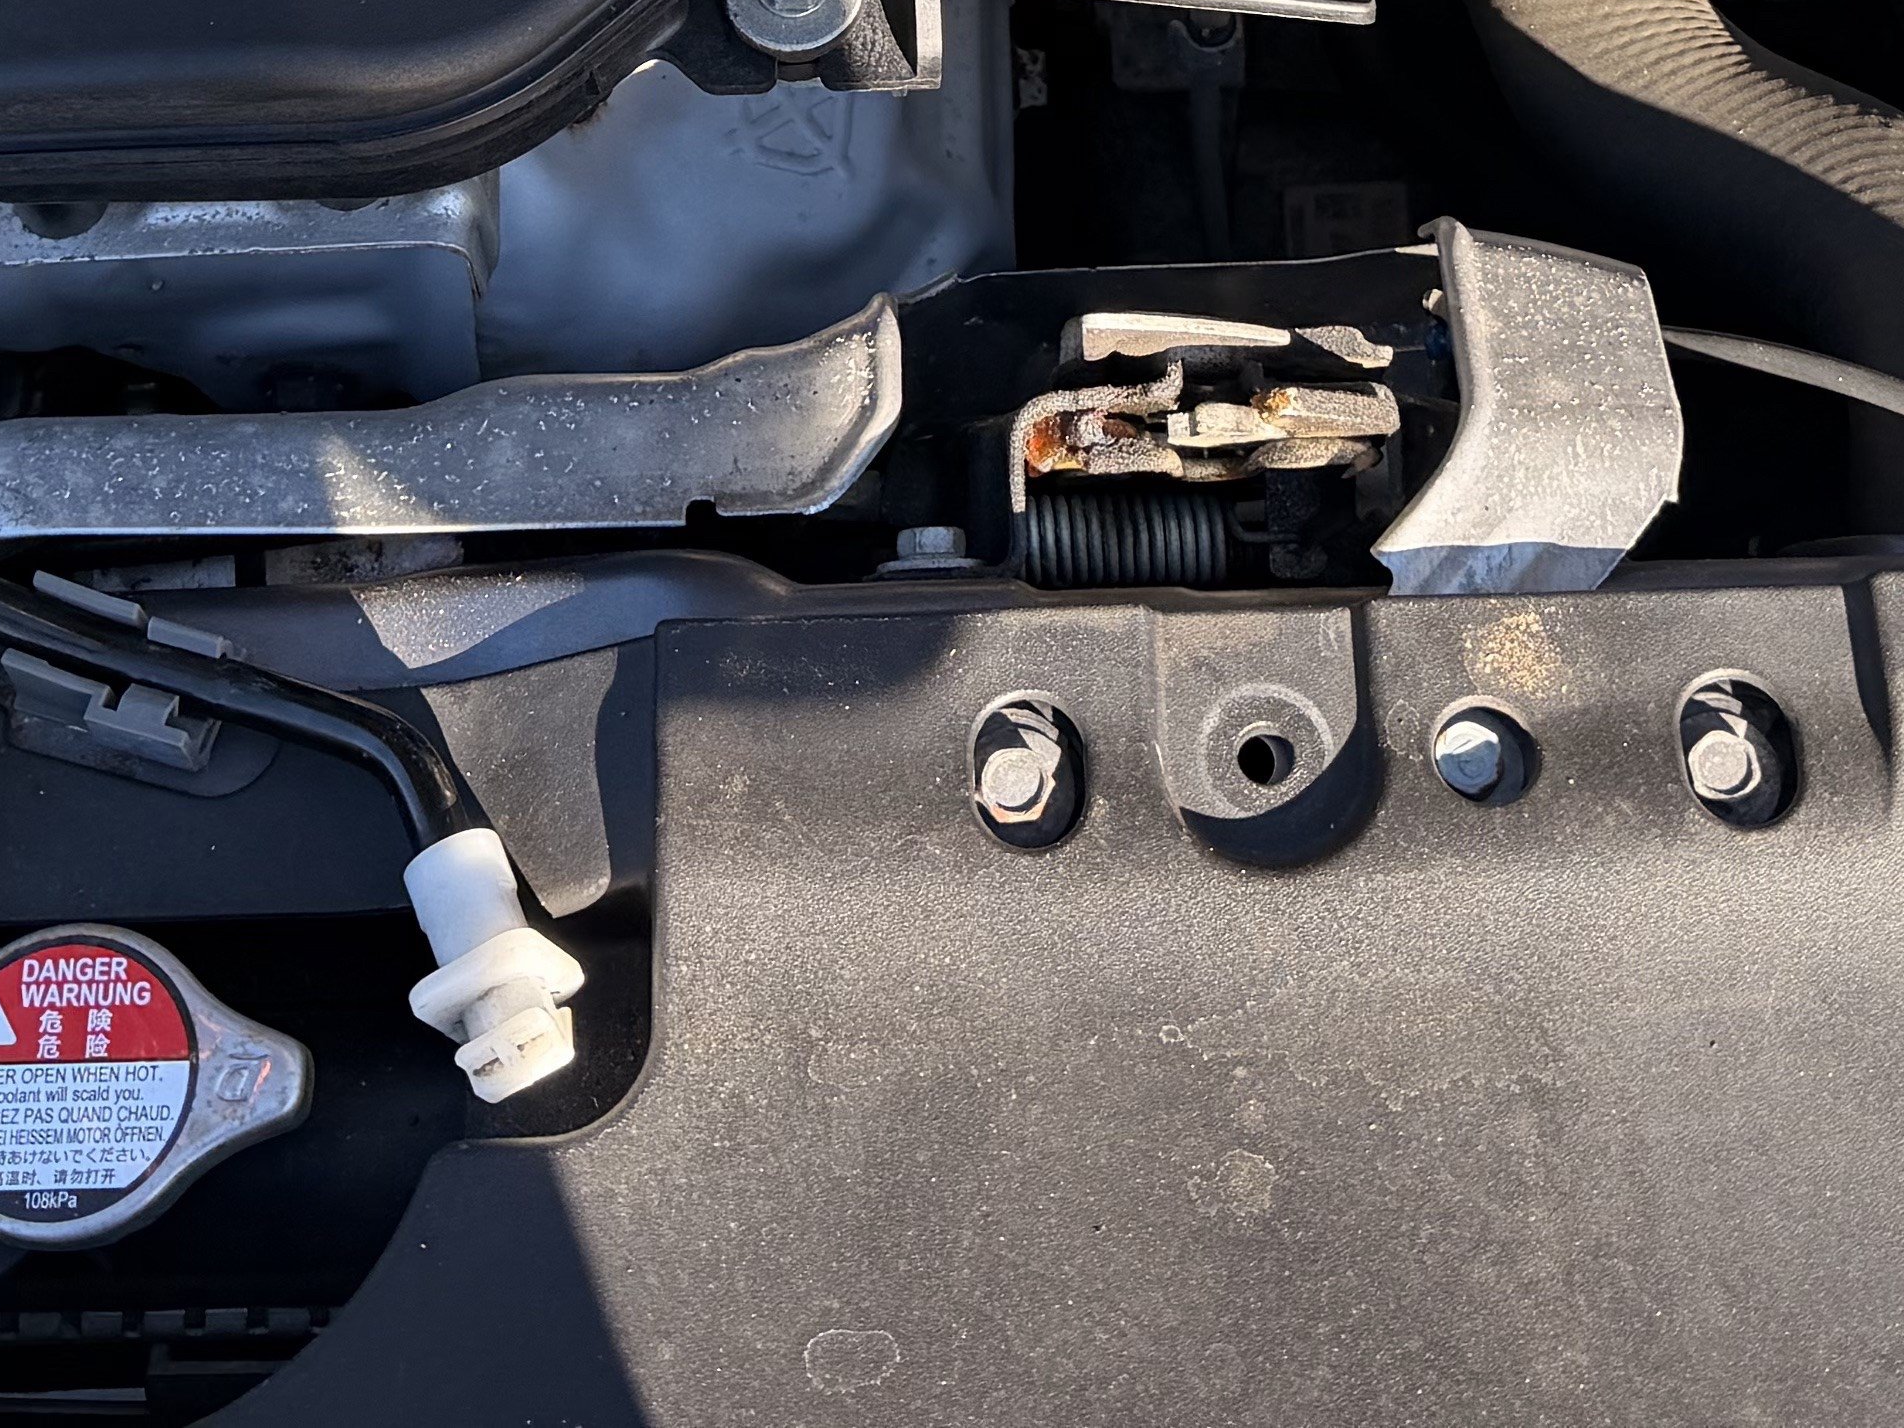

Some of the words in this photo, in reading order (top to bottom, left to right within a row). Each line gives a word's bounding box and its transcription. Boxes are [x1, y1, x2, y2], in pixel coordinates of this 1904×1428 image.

[22, 957, 128, 982] DANGER
[20, 981, 153, 1007] WARNUNG
[21, 1067, 67, 1084] OPEN
[72, 1066, 121, 1084] WHEN
[124, 1065, 164, 1082] HOT.
[45, 1086, 68, 1102] will
[72, 1086, 110, 1103] scald
[114, 1088, 145, 1107] you.
[23, 1107, 54, 1125] PAS
[58, 1106, 113, 1124] QUAND
[117, 1104, 175, 1123] CHAUD.
[10, 1128, 65, 1146] HEISSEM
[66, 1127, 111, 1145] MOTOR
[23, 1192, 79, 1210] 108kPa
